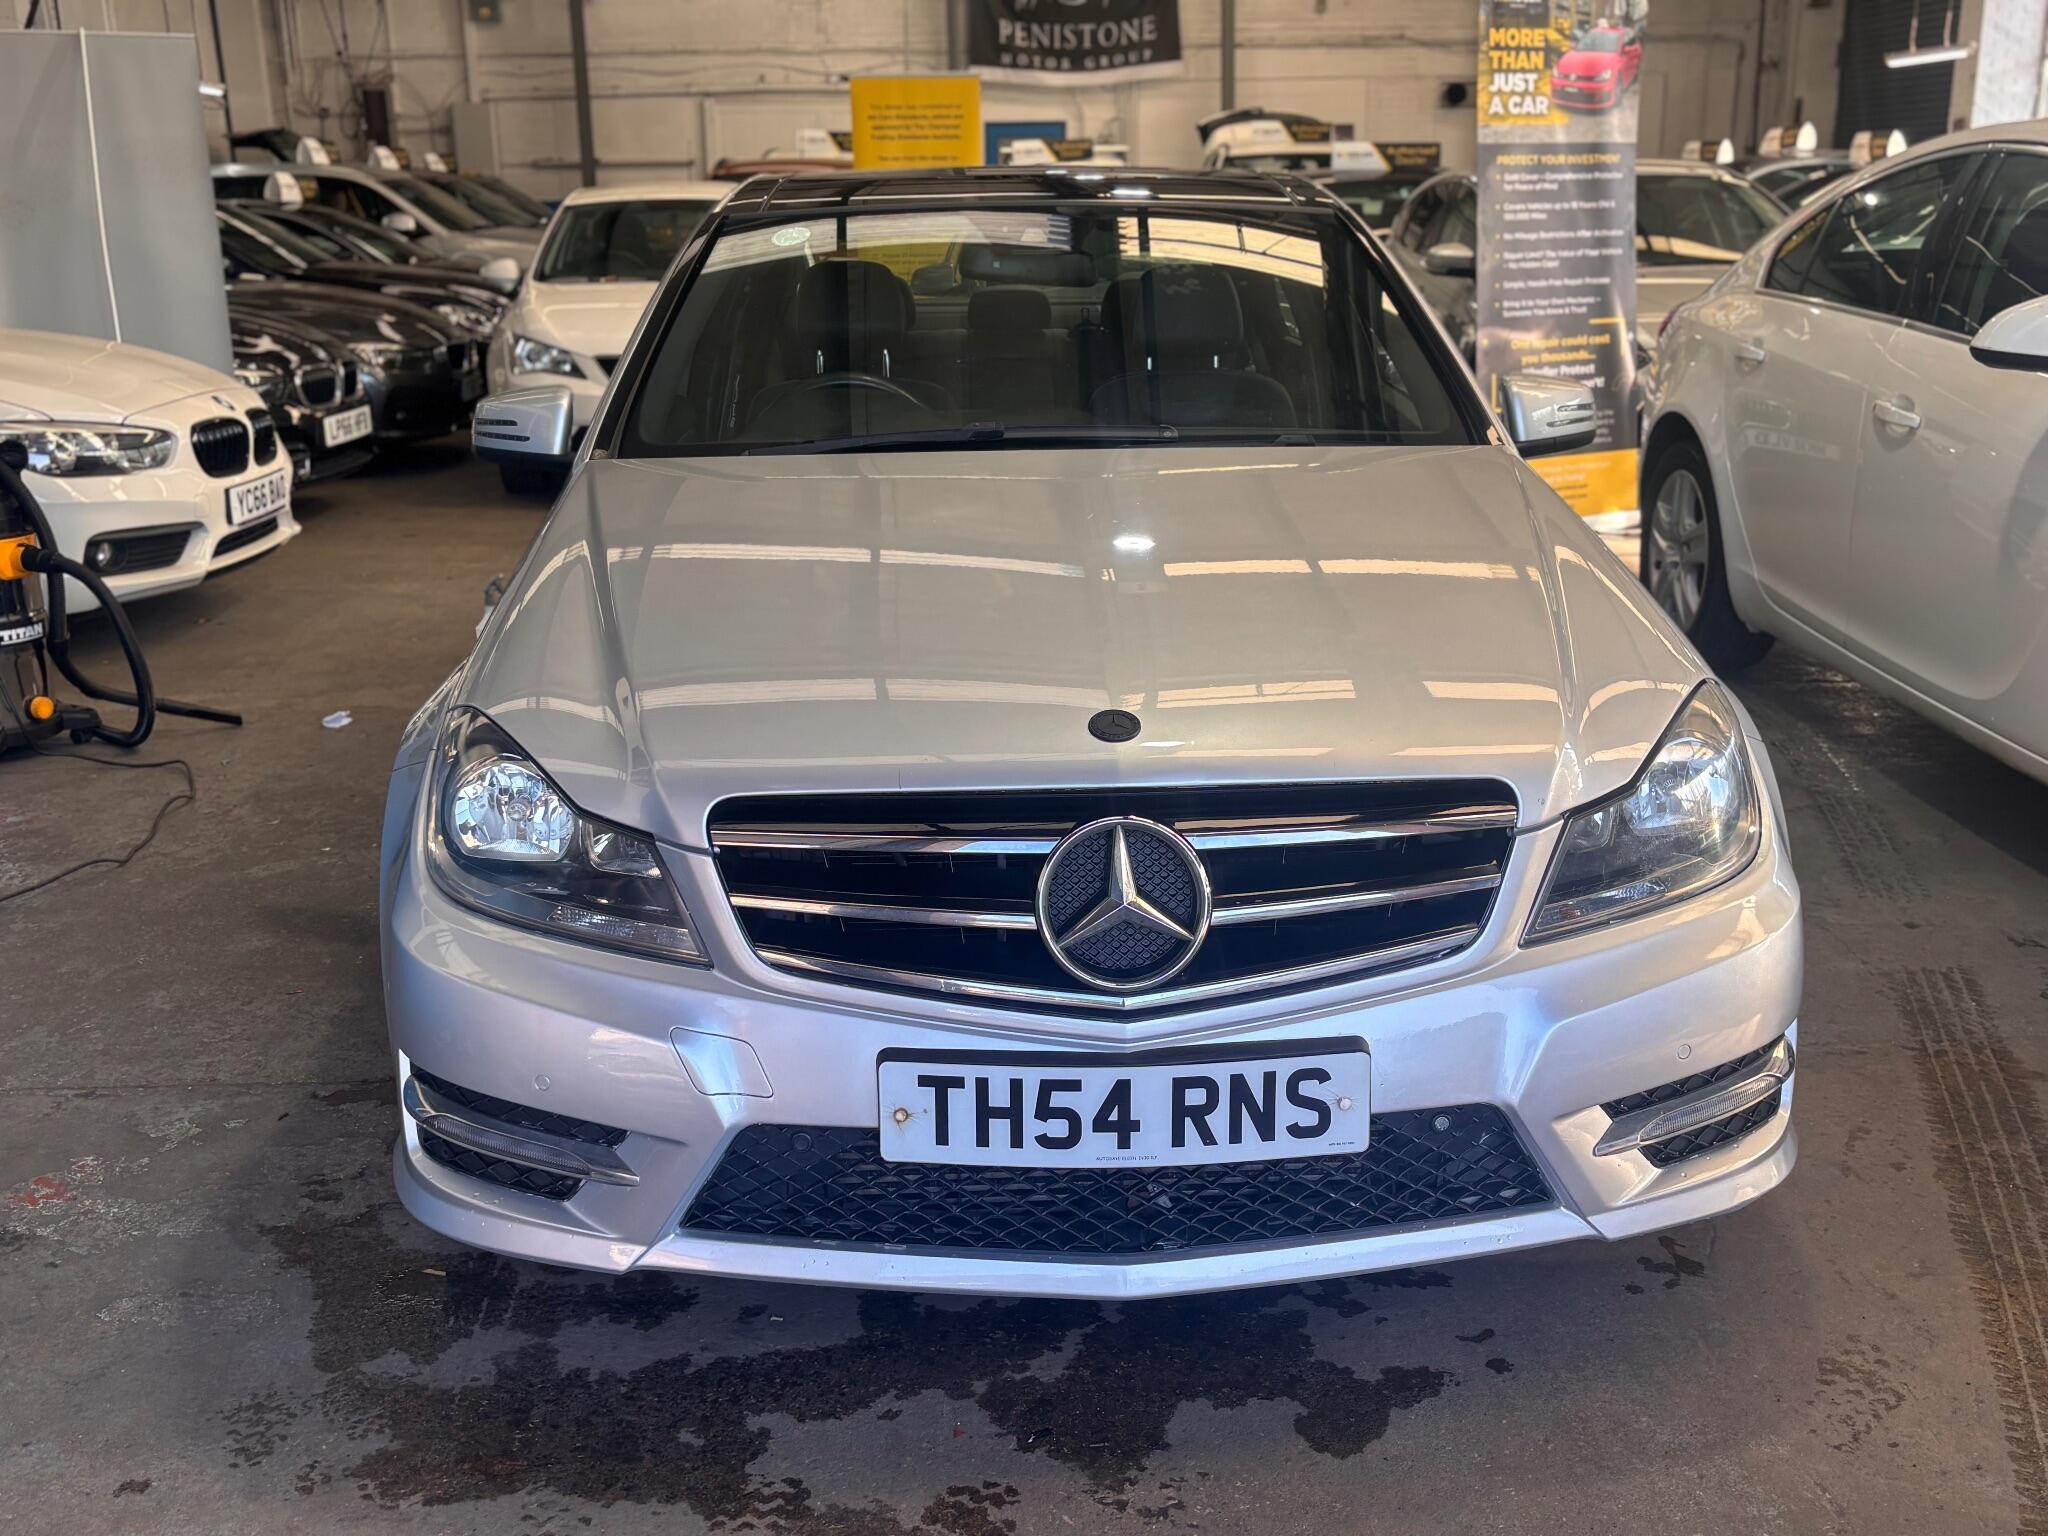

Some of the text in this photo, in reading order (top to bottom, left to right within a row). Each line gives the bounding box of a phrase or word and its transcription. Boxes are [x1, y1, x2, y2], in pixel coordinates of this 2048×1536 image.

[997, 14, 1158, 50] PENISTONE
[1488, 27, 1546, 48] MORE
[1000, 49, 1153, 71] MOTOR GROUP
[1488, 51, 1545, 70] THAN
[1488, 72, 1539, 92] JUST
[1488, 95, 1550, 115] A CAR
[1496, 153, 1621, 166] PROTECT YOUR INVESTMENT
[1510, 339, 1531, 350] One
[1561, 334, 1588, 346] could
[1588, 333, 1612, 345] cost
[1520, 354, 1539, 366] you
[1560, 364, 1596, 376] Protect
[236, 482, 268, 517] YC66
[0, 621, 43, 642] TITAN
[917, 1067, 1333, 1150] TH54 RNS
